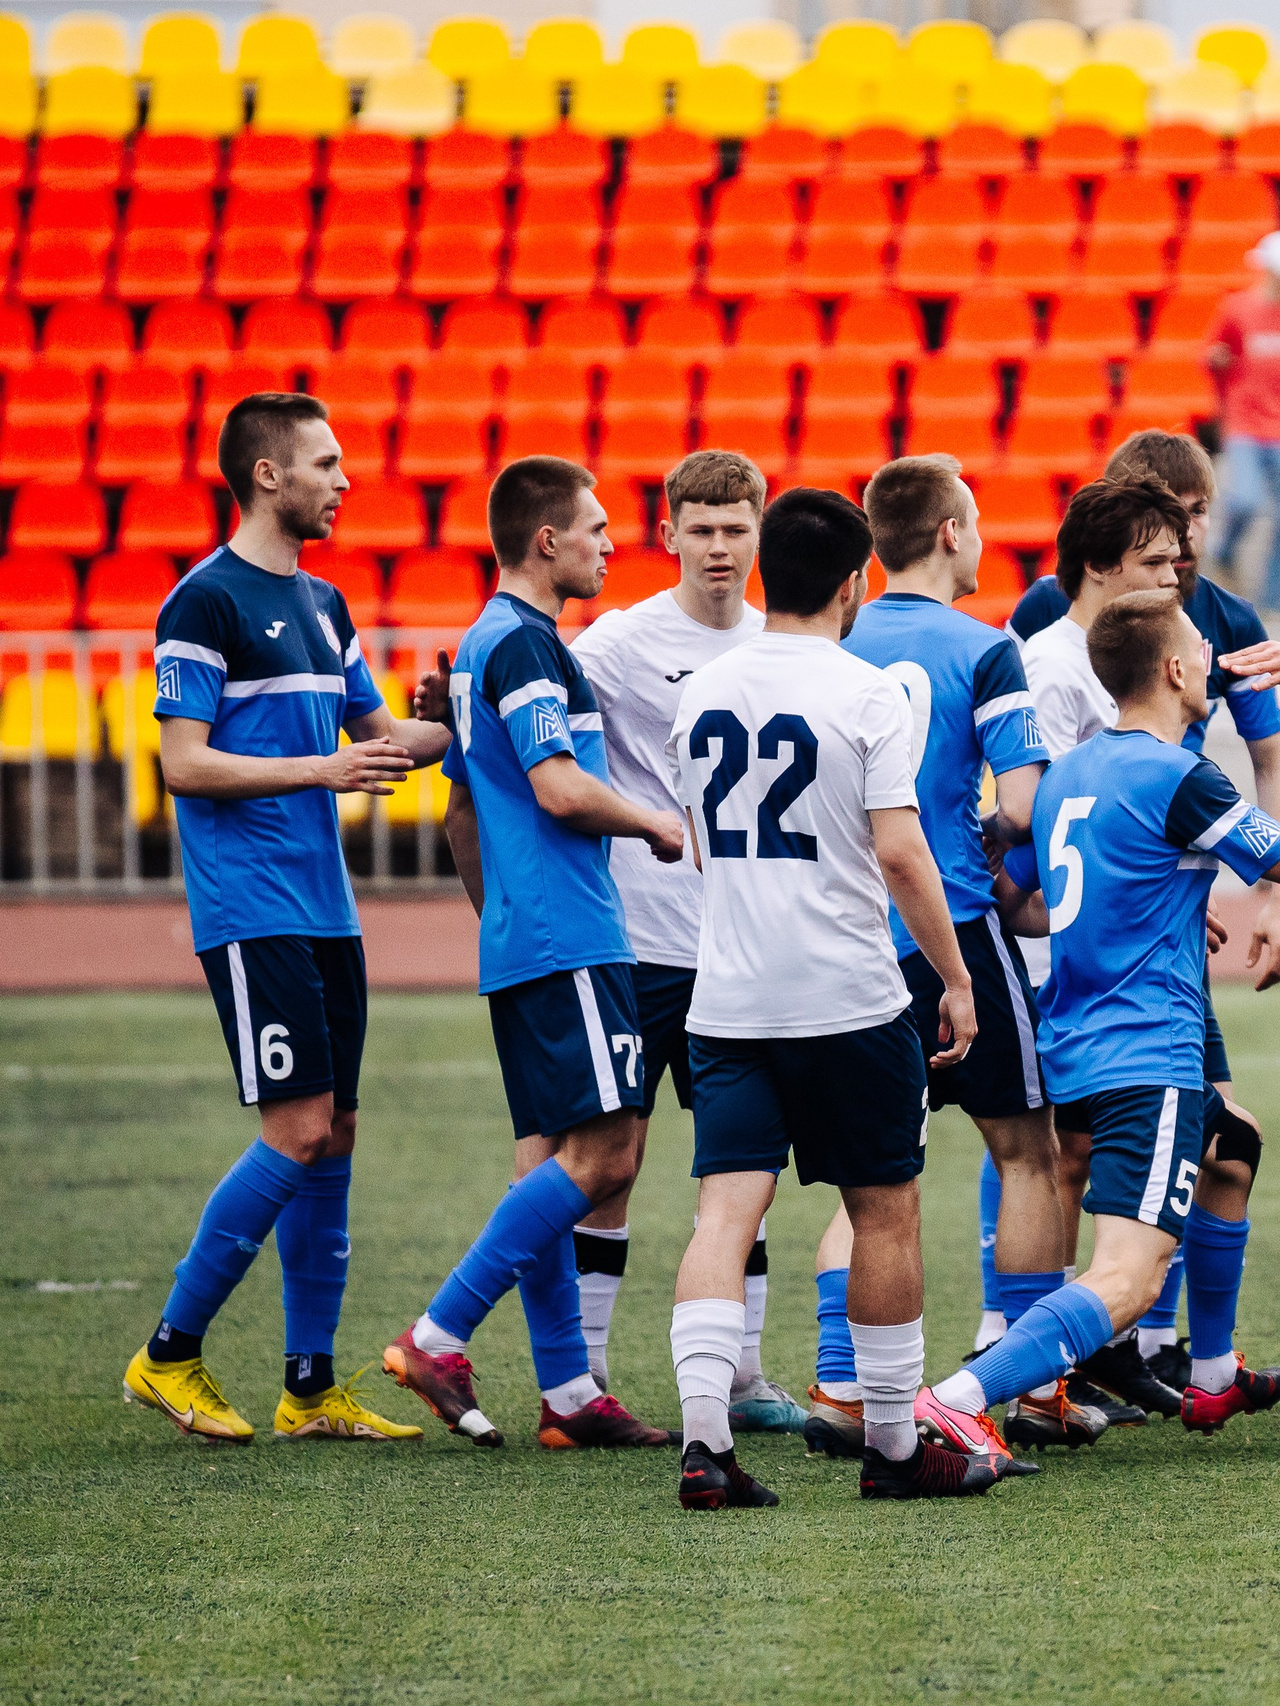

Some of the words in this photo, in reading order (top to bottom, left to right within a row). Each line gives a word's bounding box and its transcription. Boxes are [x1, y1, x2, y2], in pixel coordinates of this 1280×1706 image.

[689, 709, 819, 862] 22
[1049, 796, 1098, 935] 5
[260, 1023, 294, 1080] 6
[1169, 1158, 1200, 1217] 5
